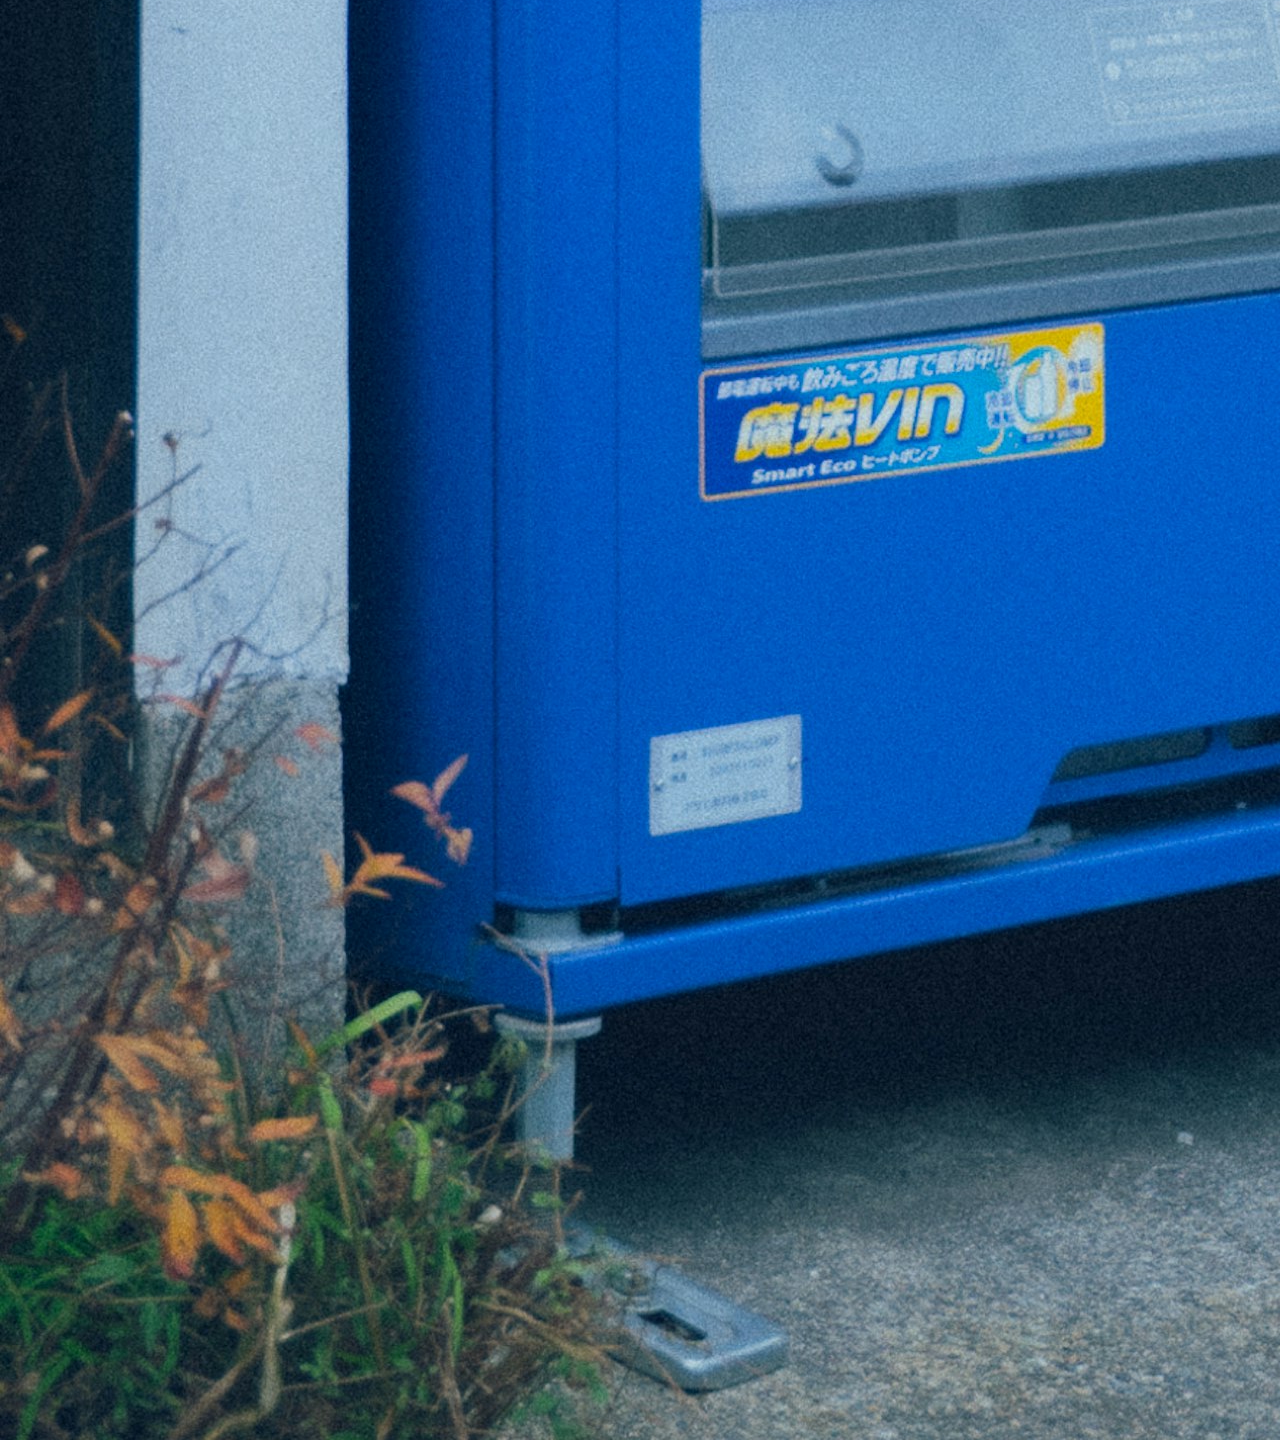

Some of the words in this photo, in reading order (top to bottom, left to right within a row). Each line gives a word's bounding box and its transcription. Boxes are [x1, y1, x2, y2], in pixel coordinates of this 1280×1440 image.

[751, 462, 816, 486] Smart
[819, 456, 857, 477] Eco
[861, 444, 942, 470] ヒートポンプ
